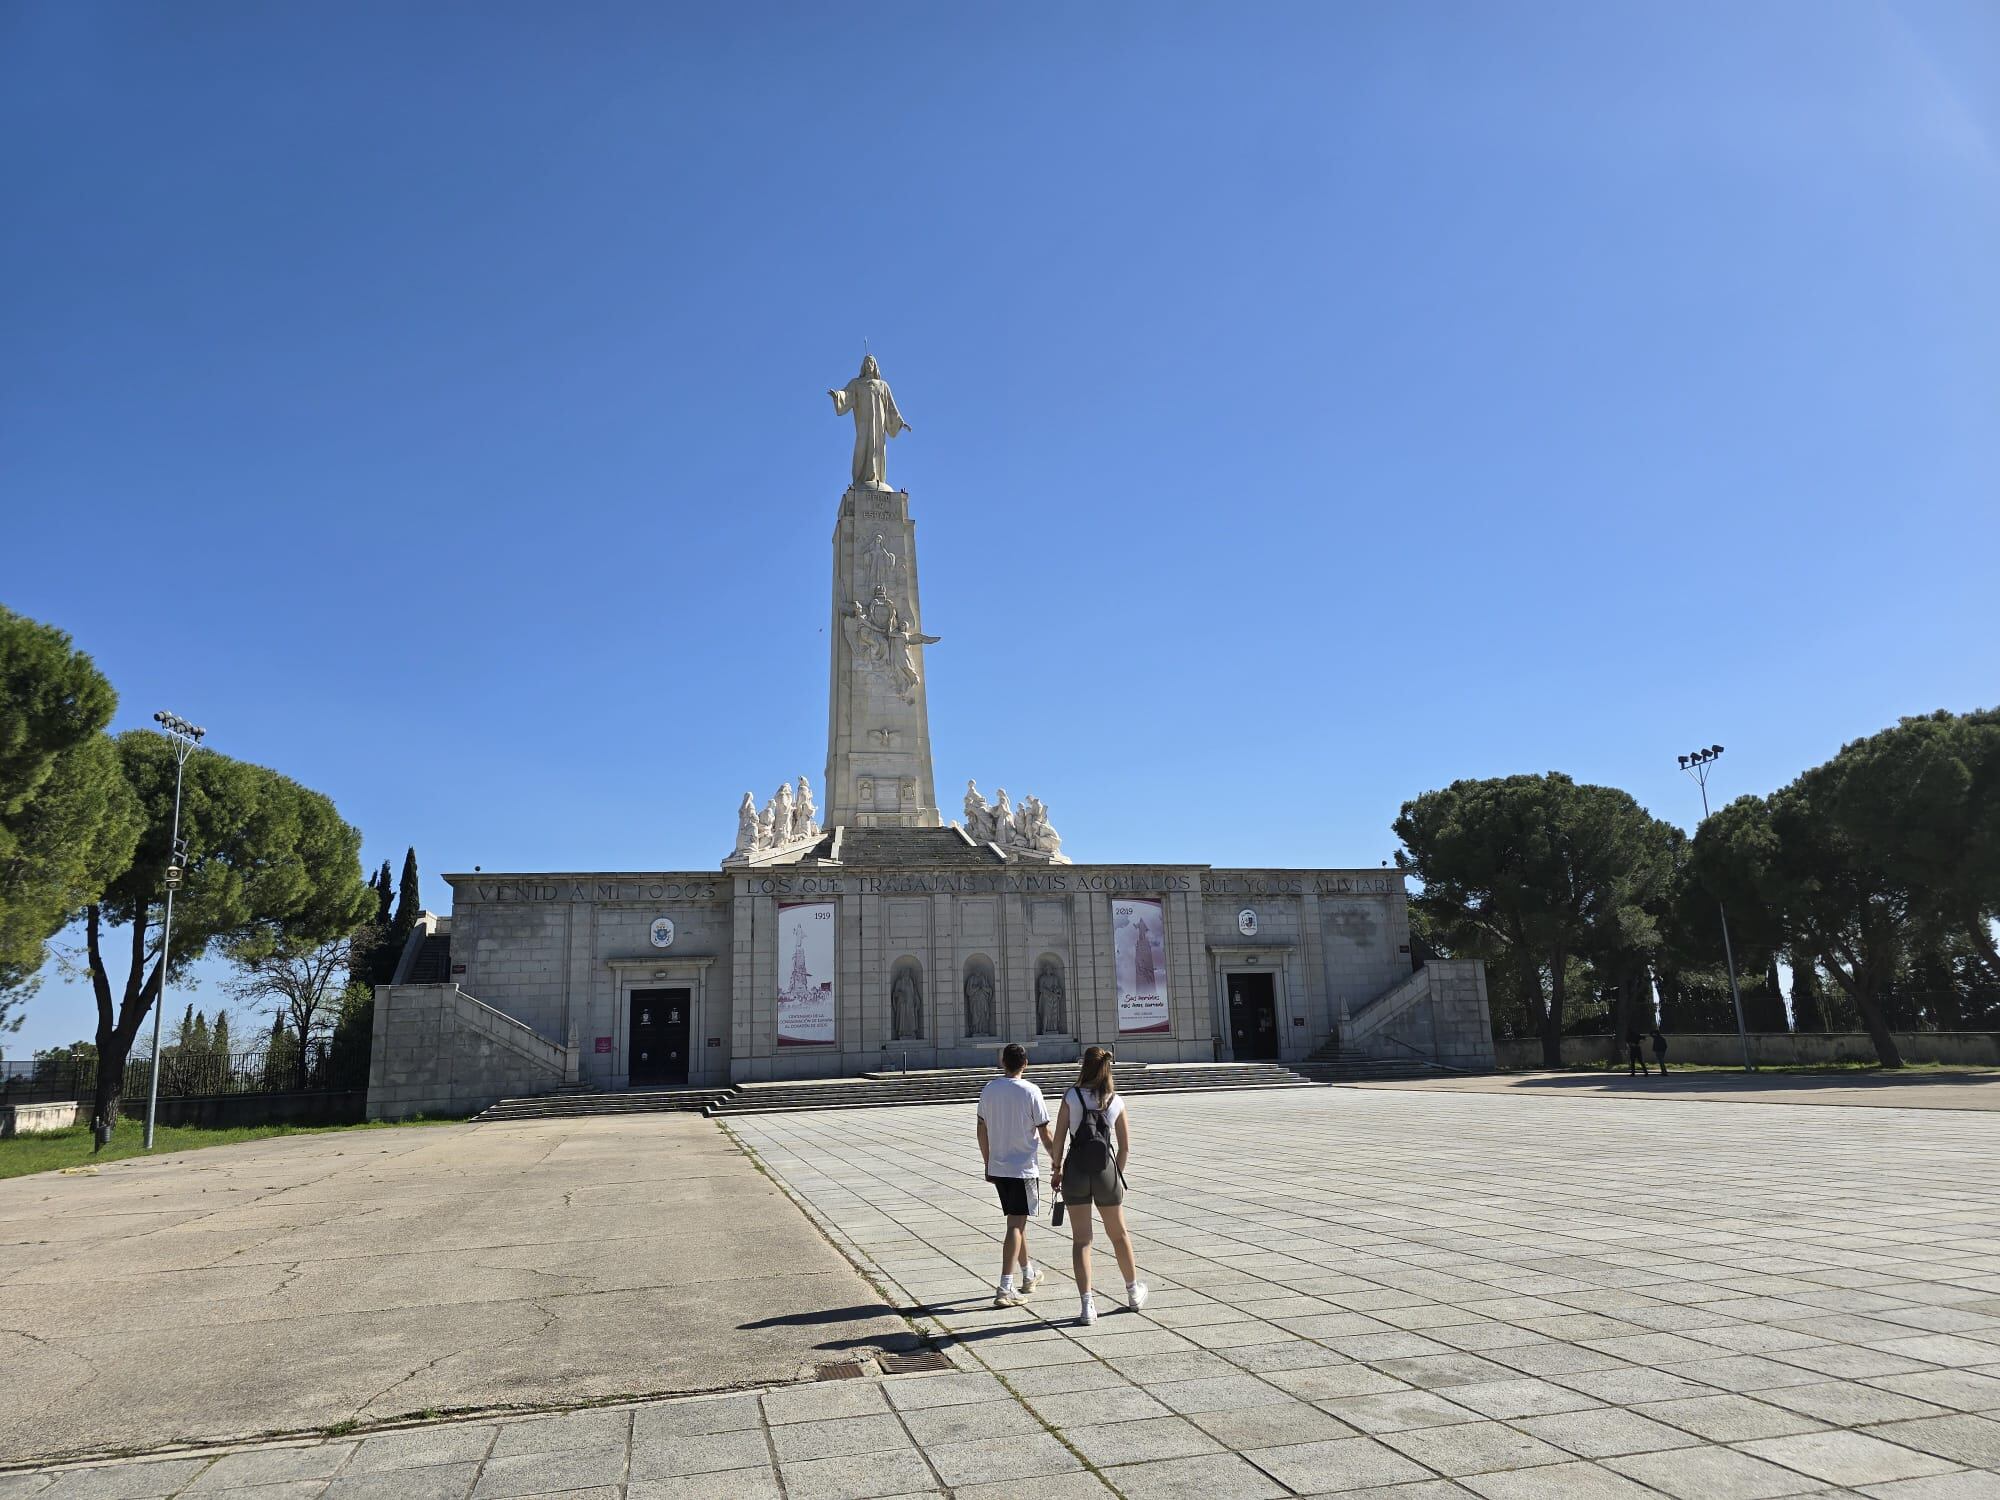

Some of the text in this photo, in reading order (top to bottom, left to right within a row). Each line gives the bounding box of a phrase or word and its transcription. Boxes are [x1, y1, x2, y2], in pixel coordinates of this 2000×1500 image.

[475, 884, 559, 901] VENID
[571, 884, 585, 900] A
[596, 884, 620, 900] MI
[633, 882, 716, 900] TODOS
[746, 878, 791, 894] LOS
[802, 878, 844, 893] QUE
[856, 876, 976, 893] TRABAJAIS
[988, 876, 998, 891] Y
[1011, 876, 1066, 891] VIVIS
[1076, 875, 1190, 891] AGOBIADOS
[1200, 879, 1233, 893] QUE
[1243, 879, 1268, 893] YO
[1278, 879, 1303, 893] OS
[1115, 907, 1133, 915] 2019
[815, 912, 831, 920] 1919
